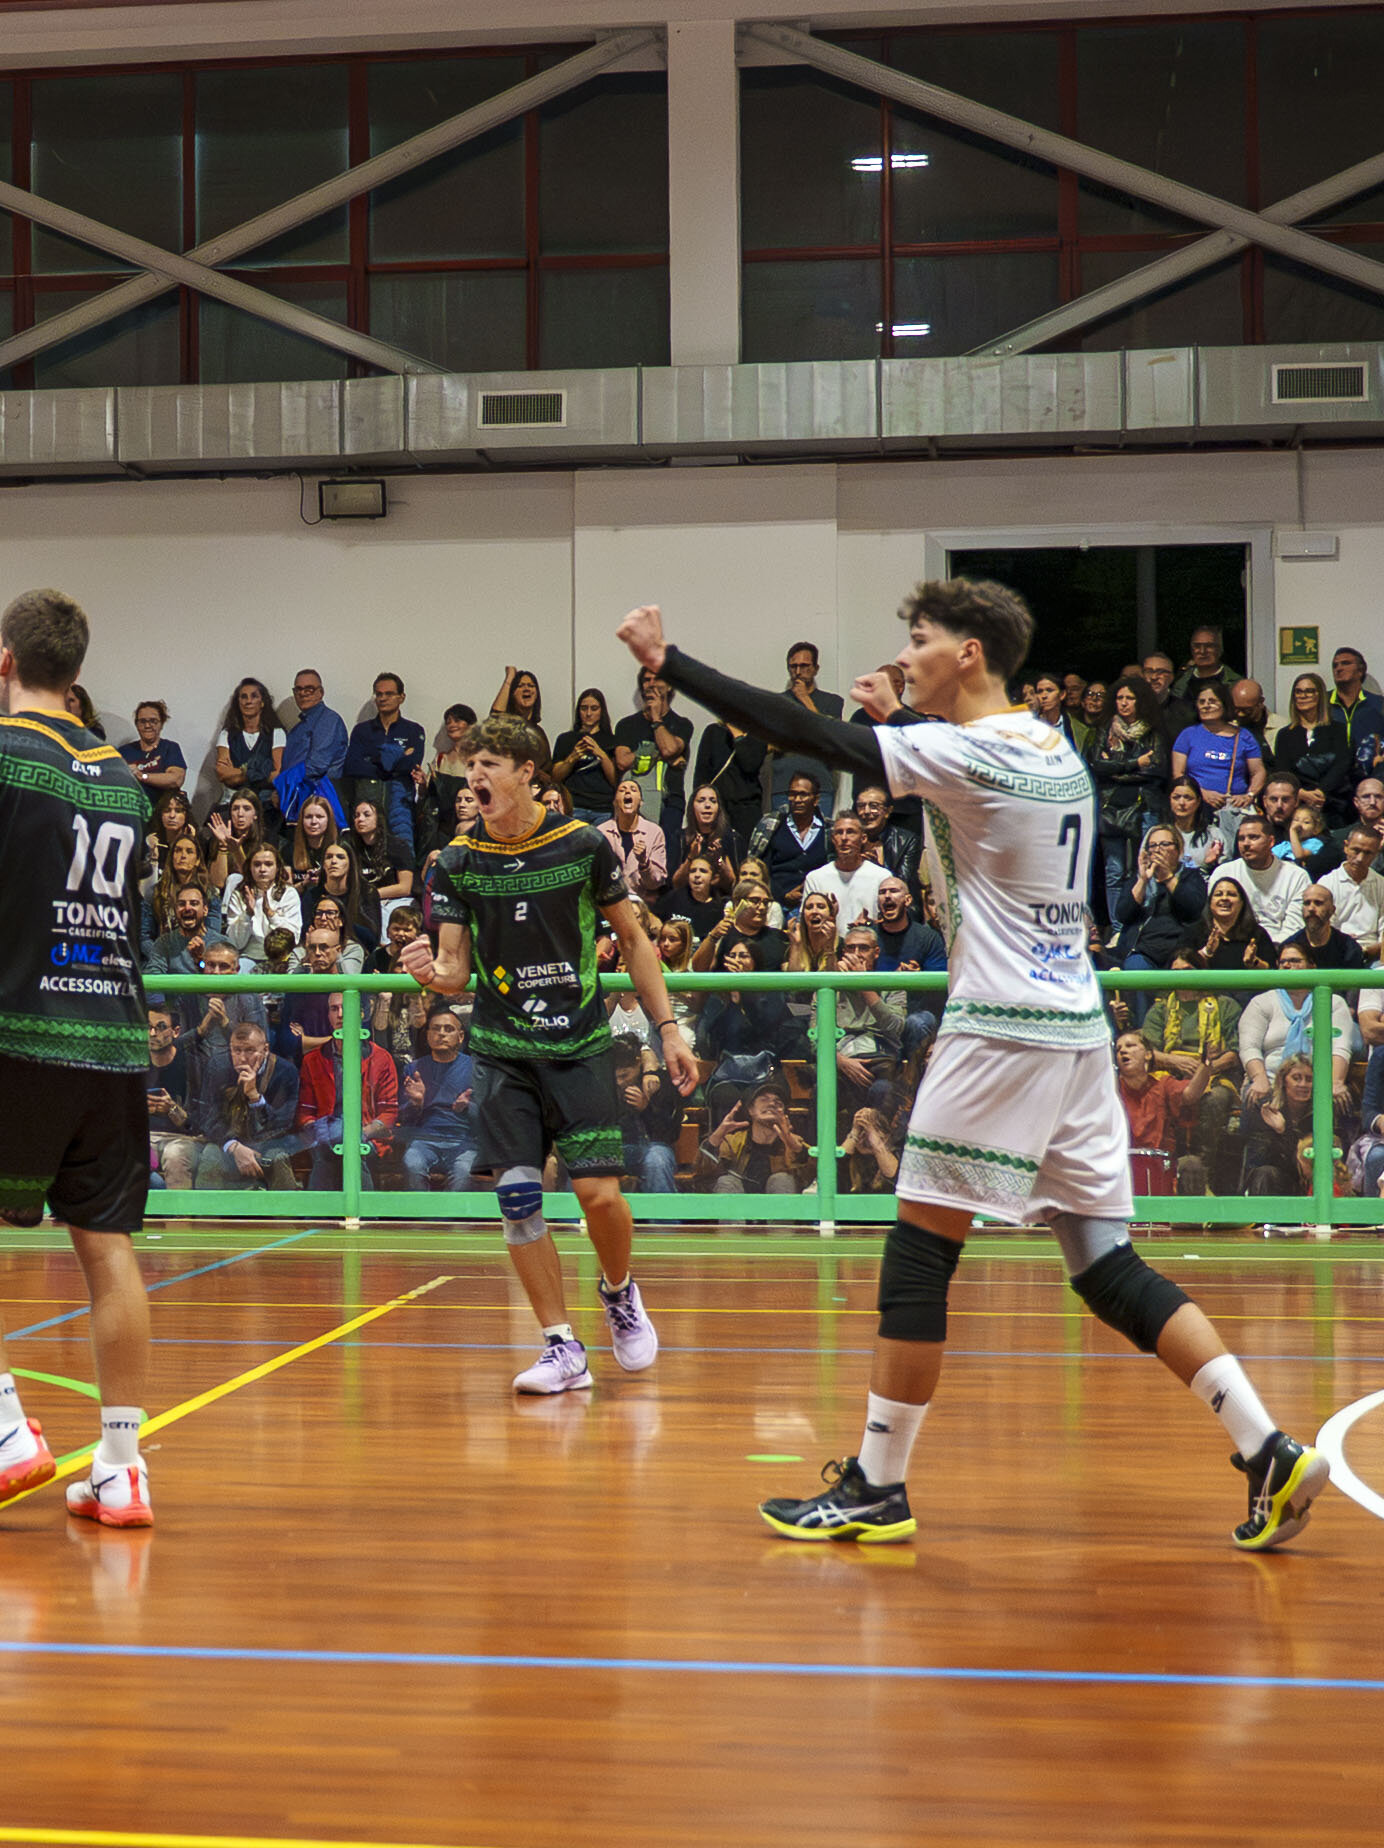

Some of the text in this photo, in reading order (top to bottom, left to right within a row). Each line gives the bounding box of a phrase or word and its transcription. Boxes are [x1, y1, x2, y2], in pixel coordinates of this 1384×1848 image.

[66, 813, 135, 898] 10
[1057, 813, 1081, 890] 7
[52, 900, 129, 933] TONON
[514, 901, 528, 921] 2
[516, 962, 574, 979] VENETA
[517, 973, 578, 989] COPERTURE
